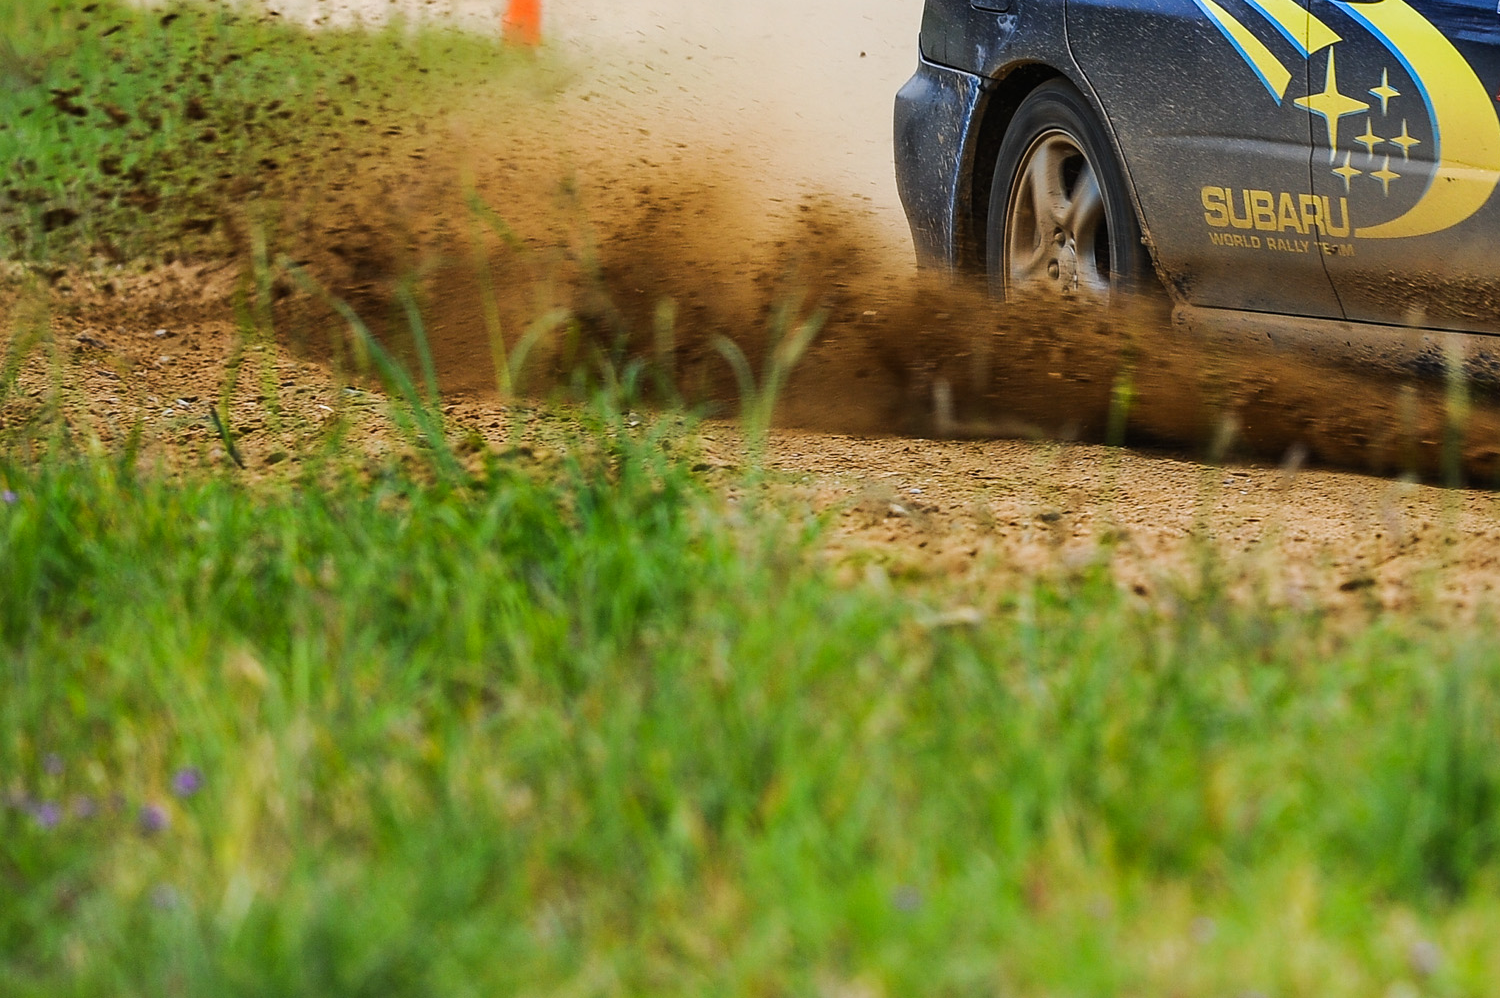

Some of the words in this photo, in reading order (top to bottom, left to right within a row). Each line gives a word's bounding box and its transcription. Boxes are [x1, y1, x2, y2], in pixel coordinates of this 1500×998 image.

[1201, 186, 1350, 238] SUBARU
[1208, 232, 1261, 249] WORLD
[1266, 237, 1309, 253] RALLY
